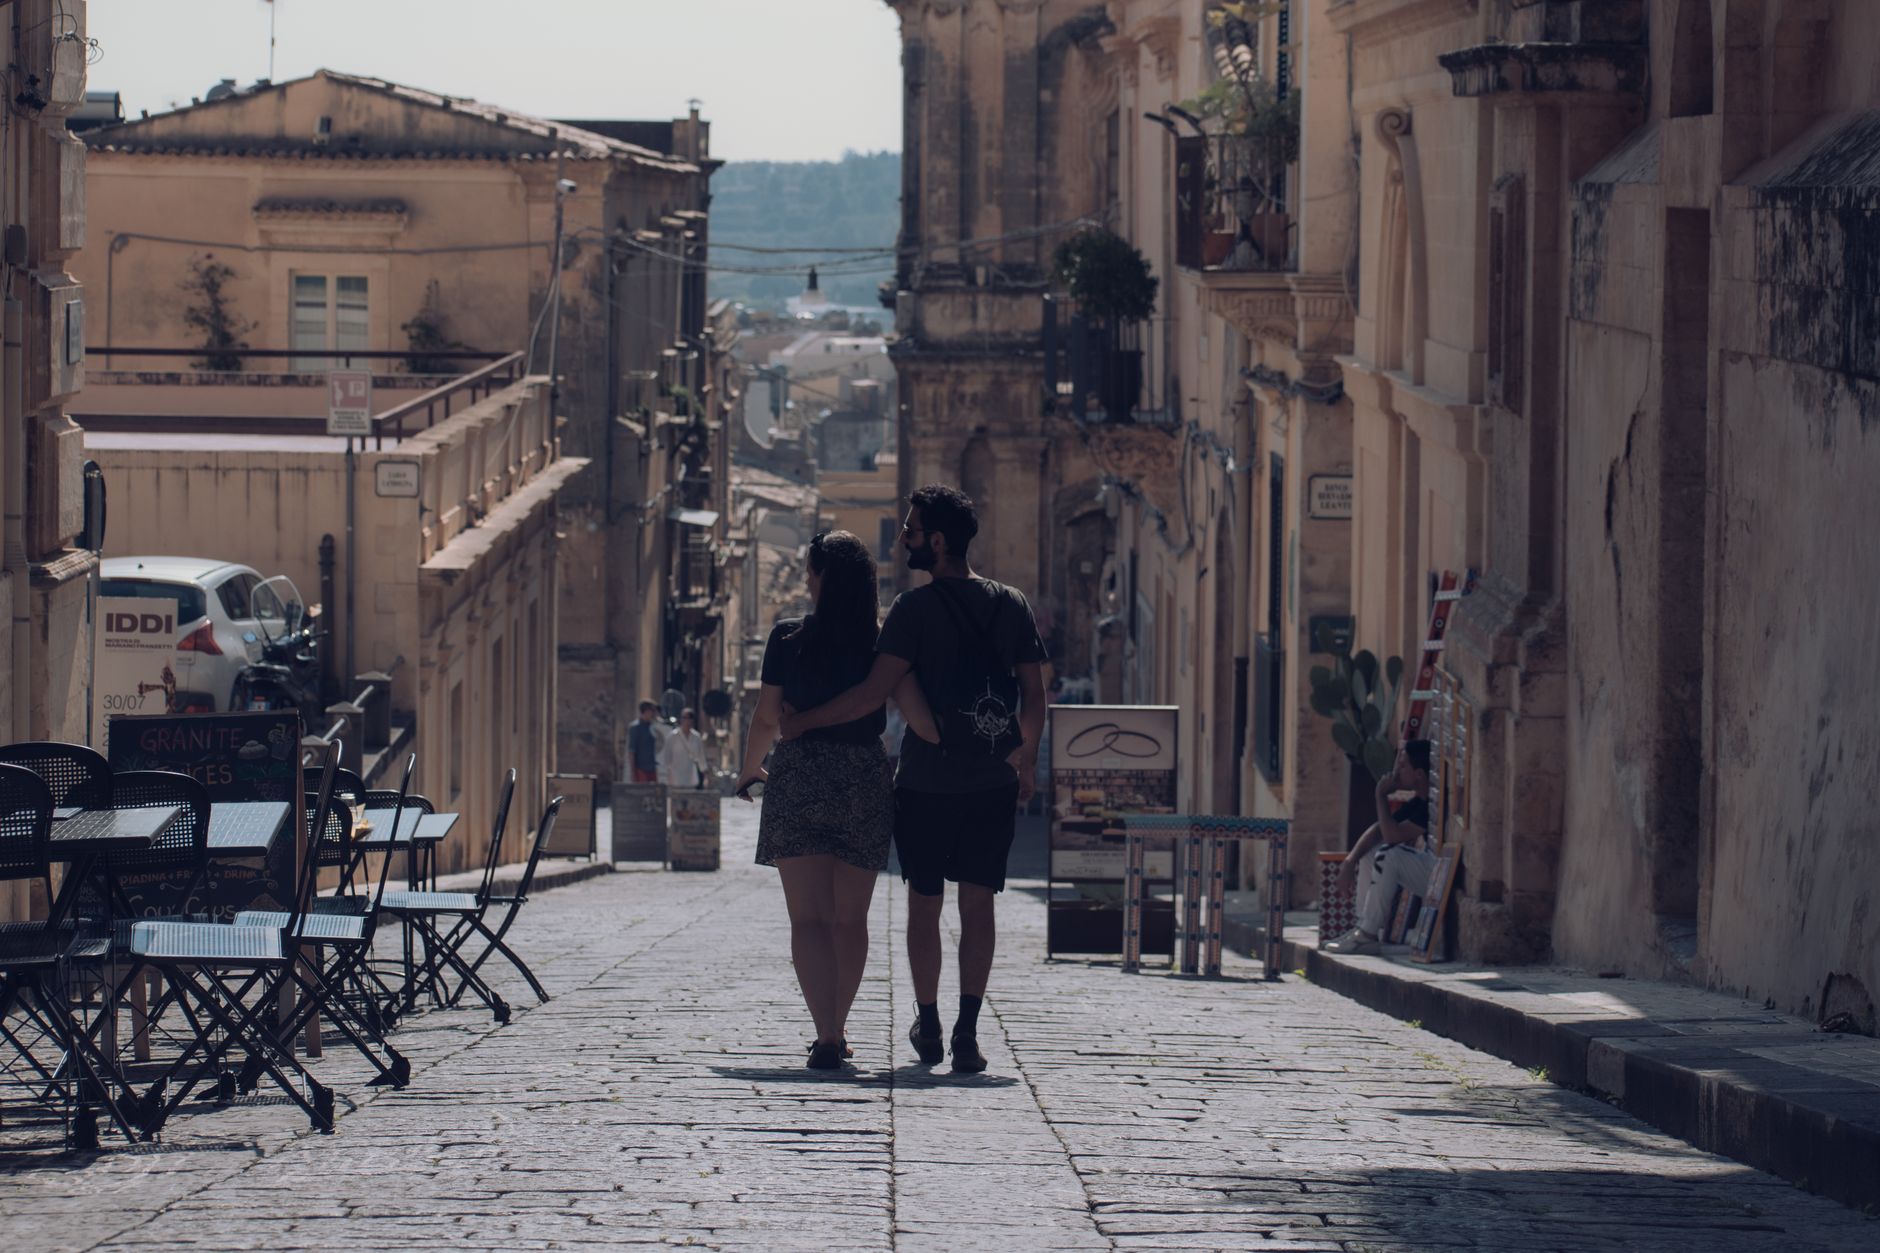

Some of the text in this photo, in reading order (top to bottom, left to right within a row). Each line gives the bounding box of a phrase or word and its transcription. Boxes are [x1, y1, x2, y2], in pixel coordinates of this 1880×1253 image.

[106, 613, 173, 634] IDDI
[103, 695, 146, 710] 30/07
[139, 723, 244, 752] GRANITE
[223, 869, 257, 879] DRINK
